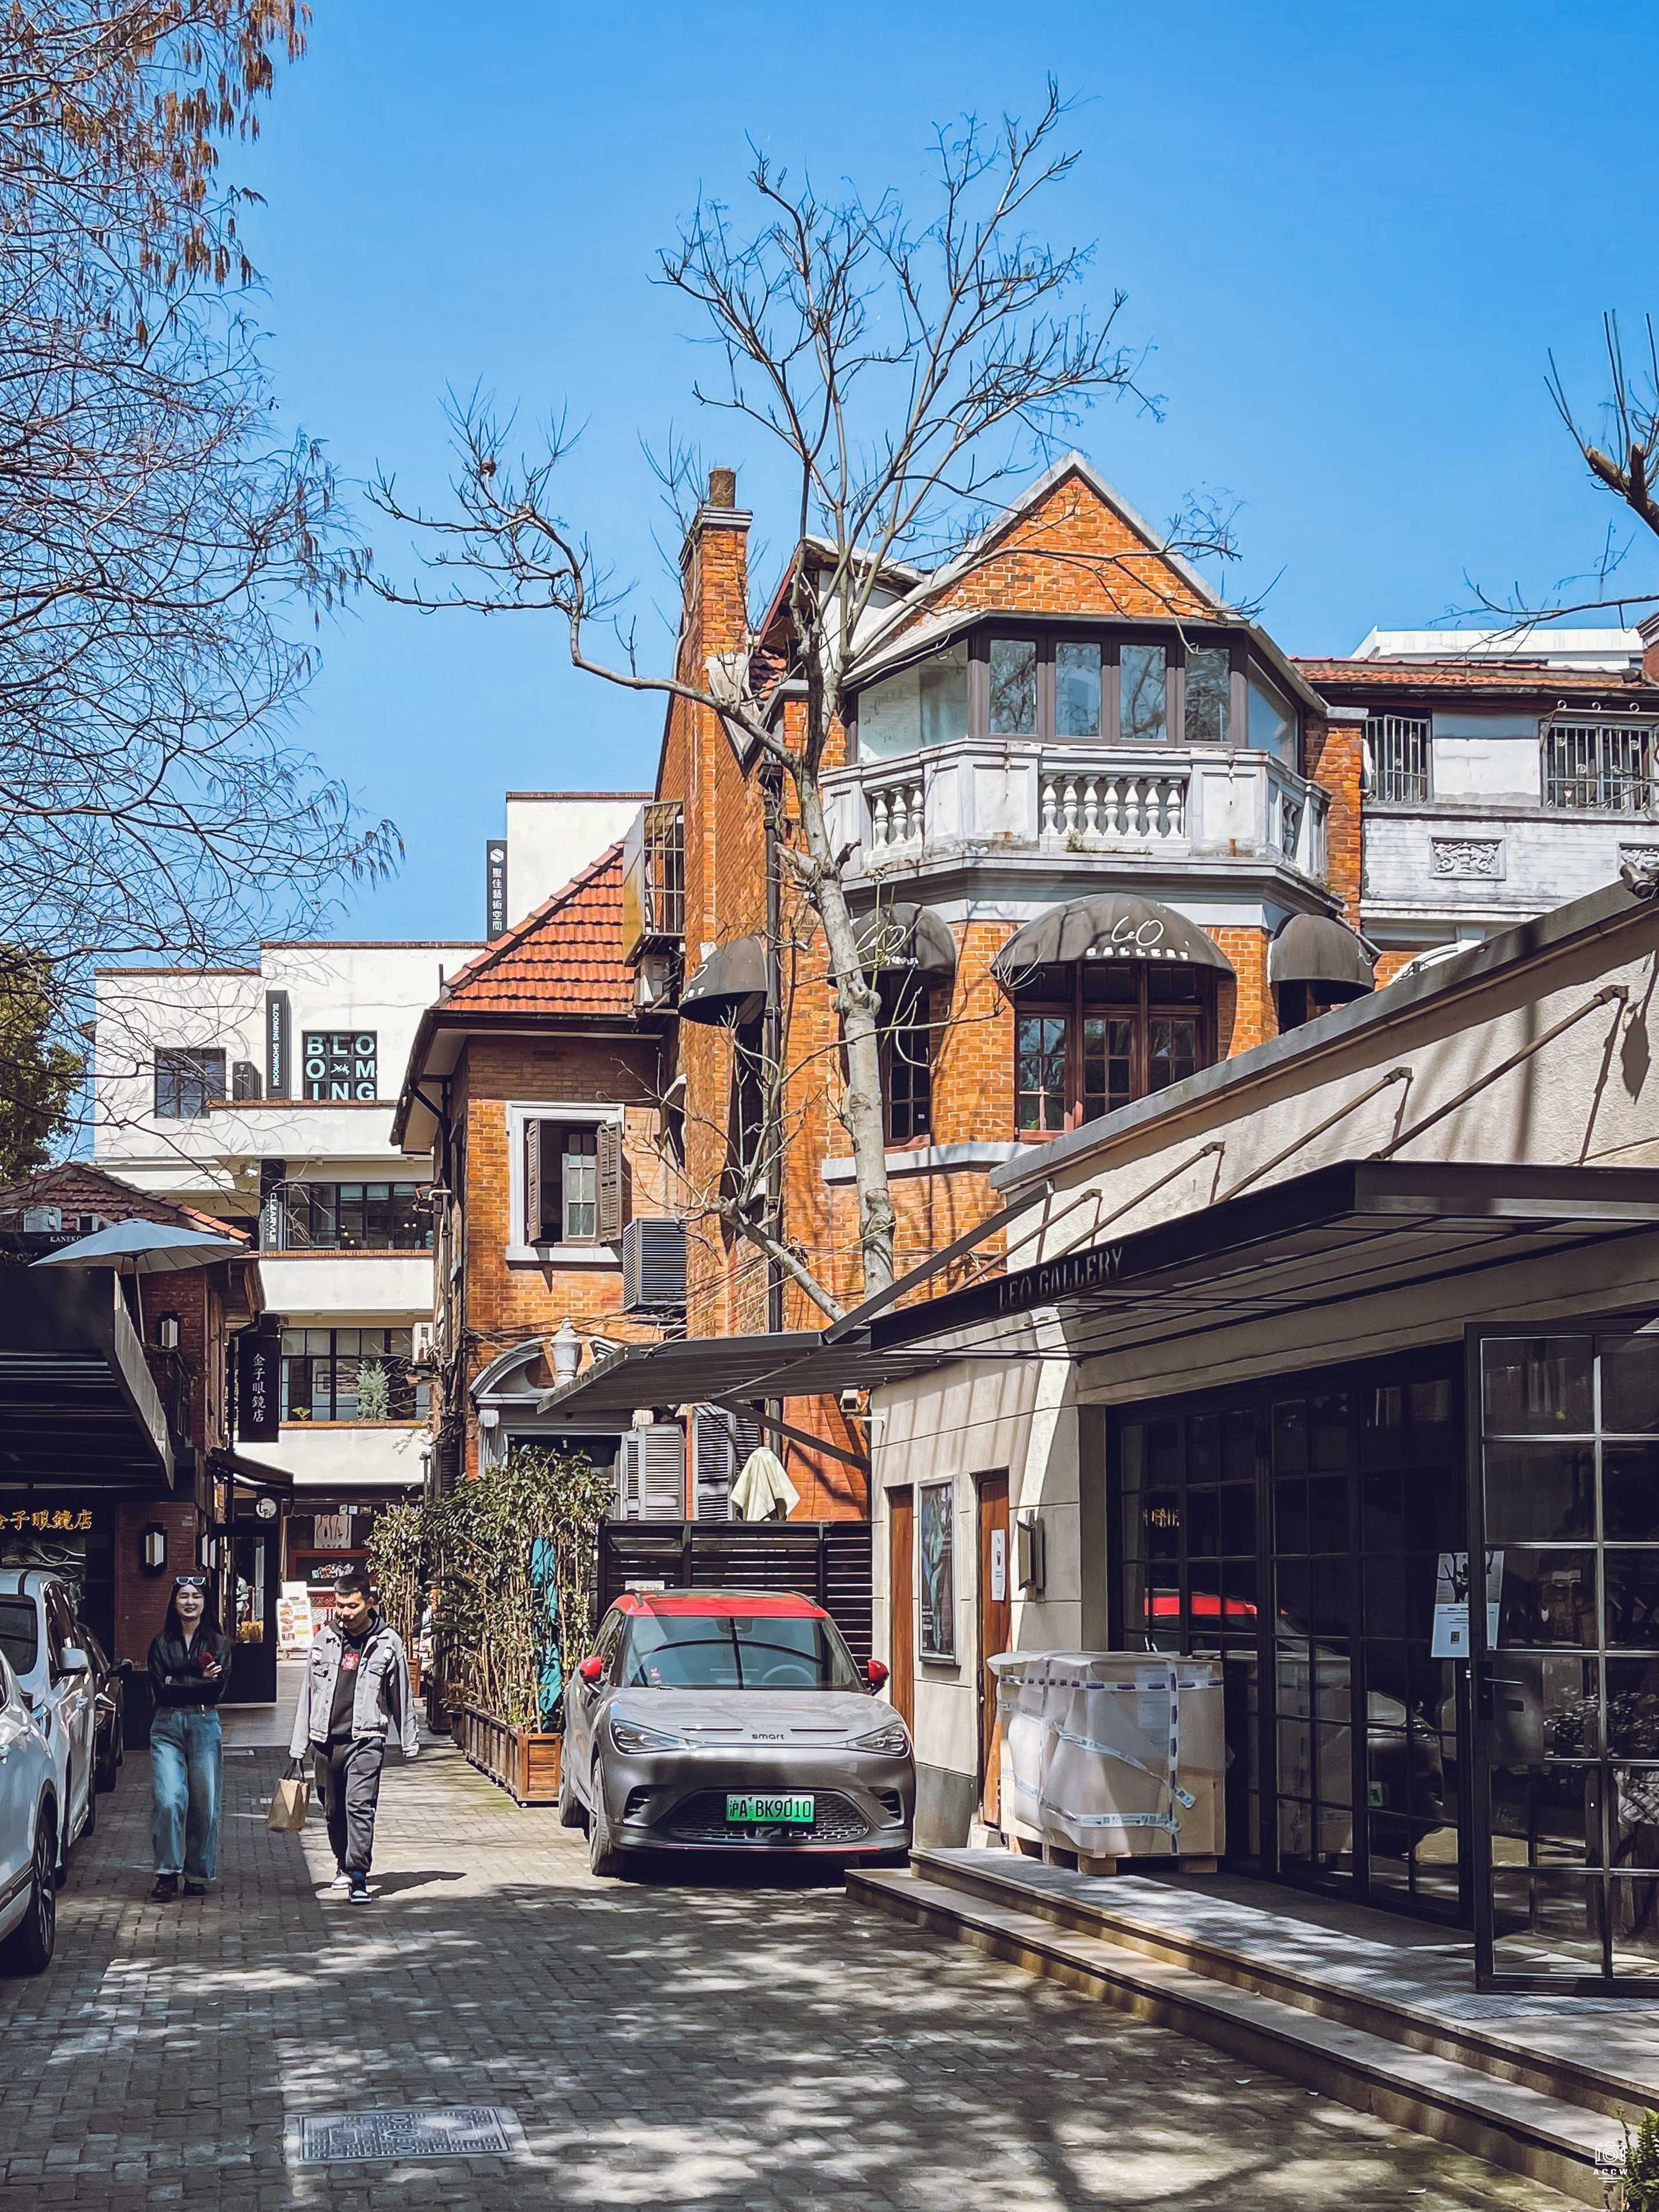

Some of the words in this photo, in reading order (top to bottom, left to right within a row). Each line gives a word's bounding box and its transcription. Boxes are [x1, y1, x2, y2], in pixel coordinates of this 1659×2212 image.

[999, 1276, 1032, 1311] LEO
[1039, 1246, 1123, 1299] GALLERY
[252, 1353, 266, 1422] 金子眼鏡店
